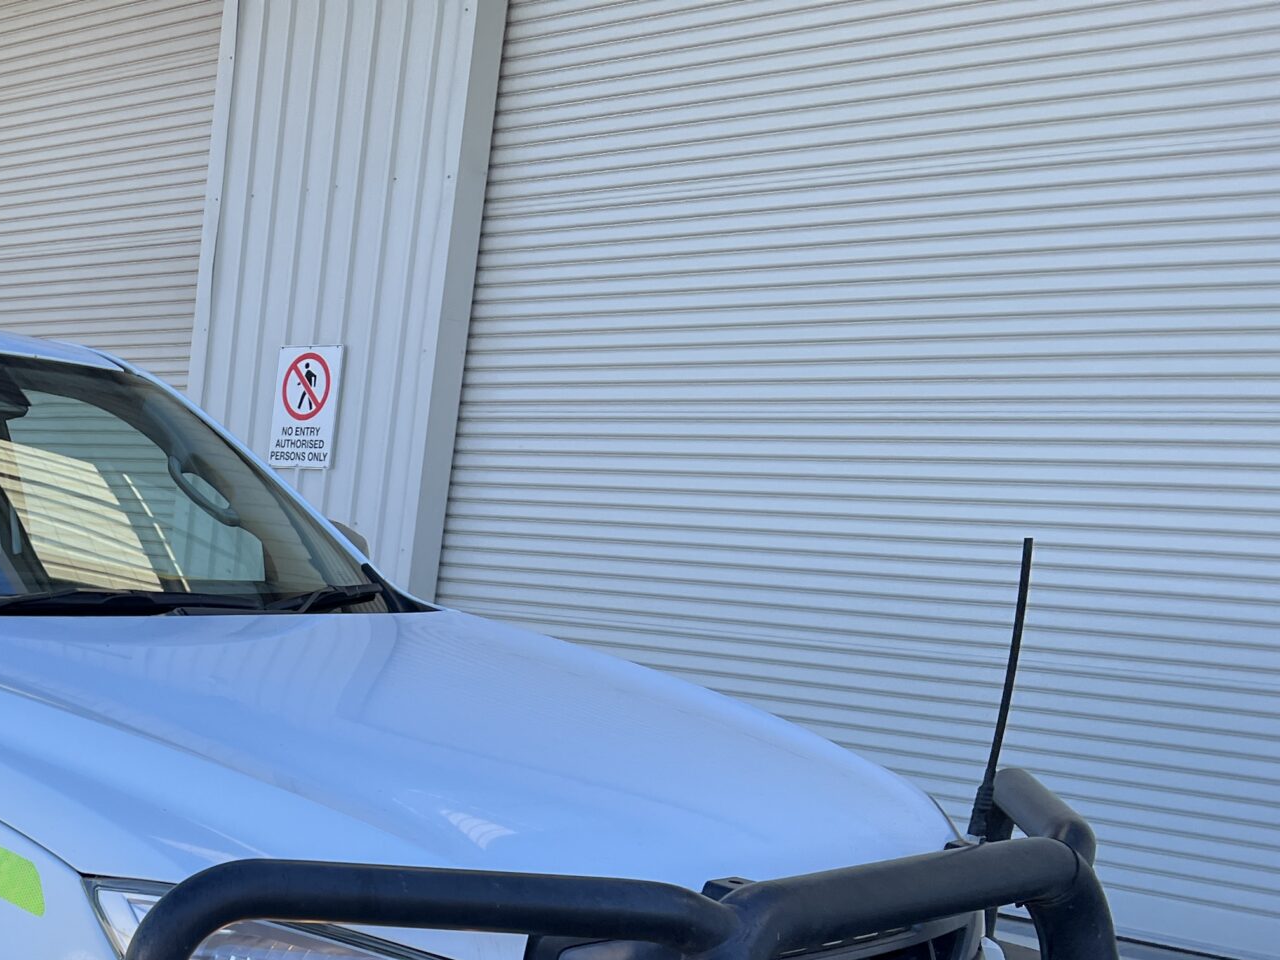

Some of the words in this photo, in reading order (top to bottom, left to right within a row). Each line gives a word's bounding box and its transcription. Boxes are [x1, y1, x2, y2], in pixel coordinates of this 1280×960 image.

[281, 427, 294, 436] NO
[295, 427, 321, 437] ENTRY
[275, 439, 325, 449] AUTHORISED
[270, 451, 306, 462] PERSONS
[307, 451, 328, 462] ONLY
